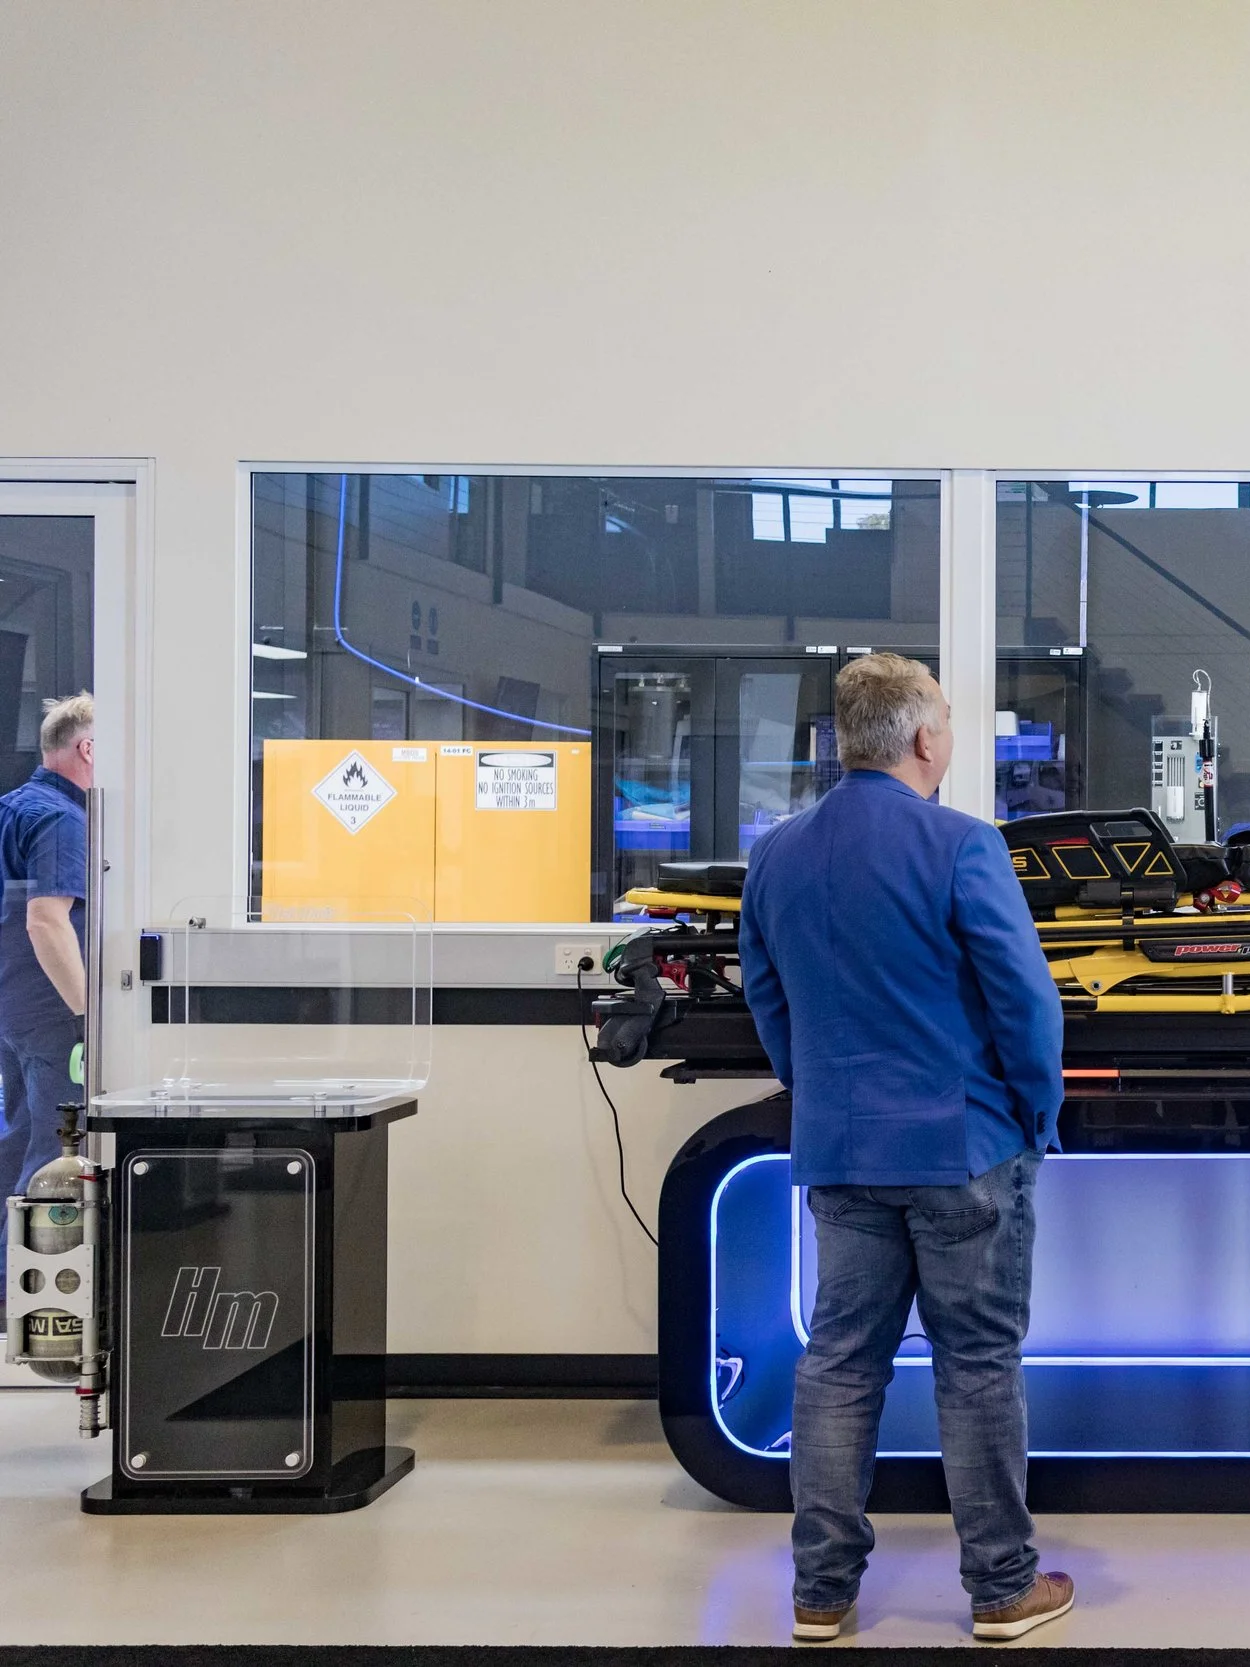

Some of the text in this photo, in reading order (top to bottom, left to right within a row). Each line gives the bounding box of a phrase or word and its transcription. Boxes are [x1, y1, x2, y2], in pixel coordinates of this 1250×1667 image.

[494, 769, 538, 781] NO SMOKING
[479, 782, 553, 794] NO IGNITION SOURCES
[327, 793, 382, 801] FLAMMABLE
[496, 795, 520, 807] WITHIN
[524, 795, 528, 807] 3
[350, 816, 356, 824] 3
